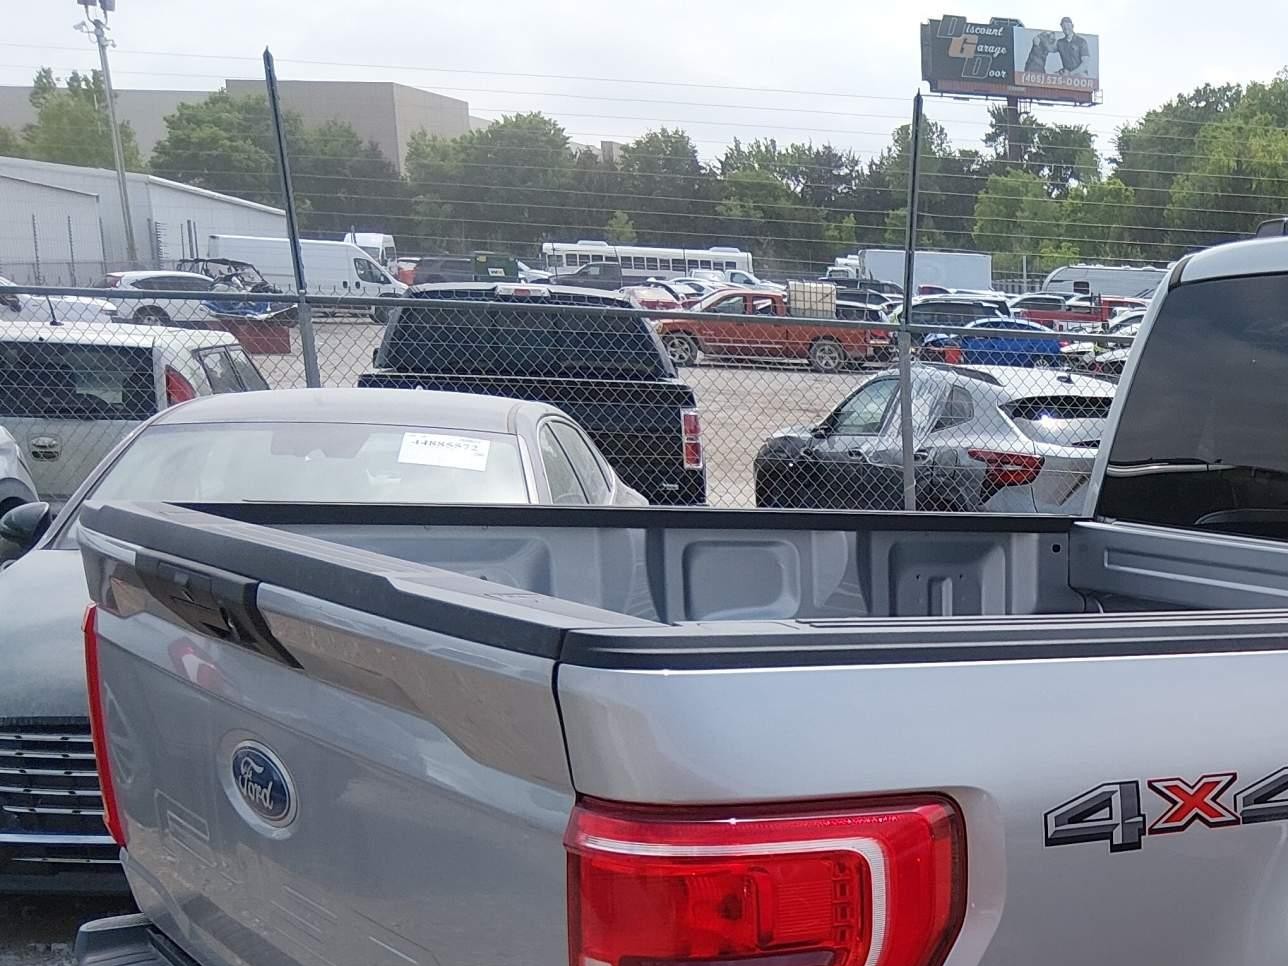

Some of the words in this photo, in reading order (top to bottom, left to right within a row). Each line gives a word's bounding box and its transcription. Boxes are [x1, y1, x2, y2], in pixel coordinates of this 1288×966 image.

[937, 15, 1003, 38] Discount
[948, 35, 1007, 58] Garage
[962, 54, 1007, 78] Door
[238, 756, 274, 810] Ford
